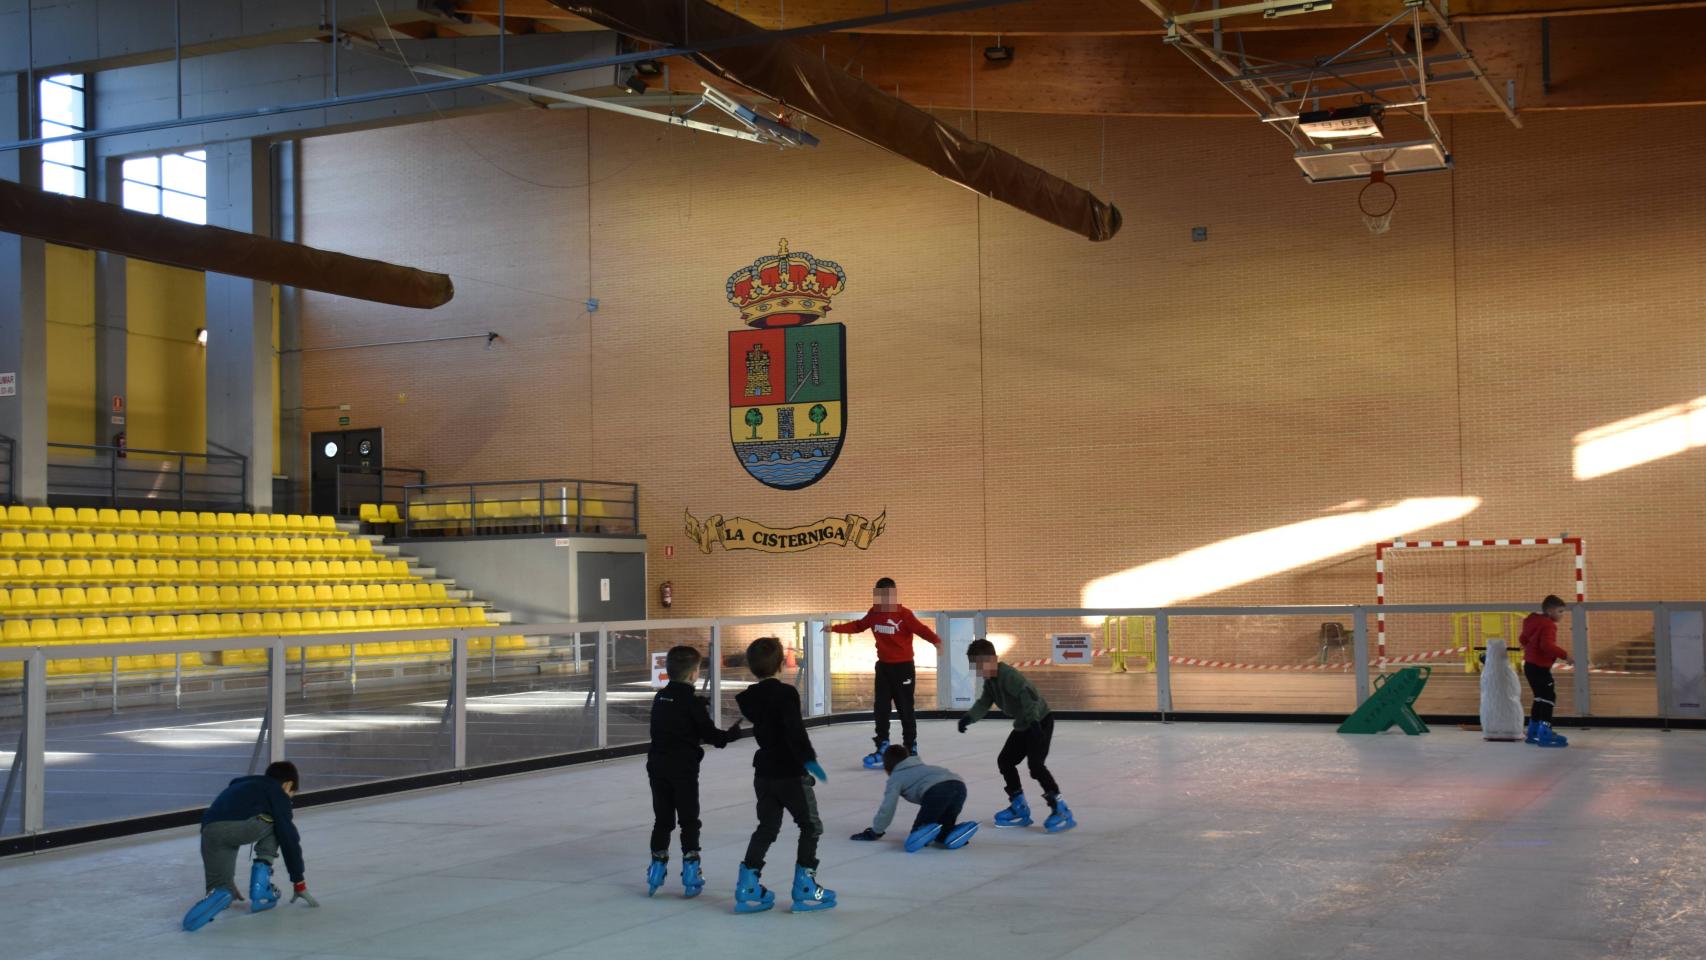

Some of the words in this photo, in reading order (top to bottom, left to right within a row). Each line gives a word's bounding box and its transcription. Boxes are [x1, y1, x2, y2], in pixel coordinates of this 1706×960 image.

[725, 528, 745, 541] LA
[752, 526, 845, 548] CISTERNIGA
[874, 624, 895, 635] PUMA
